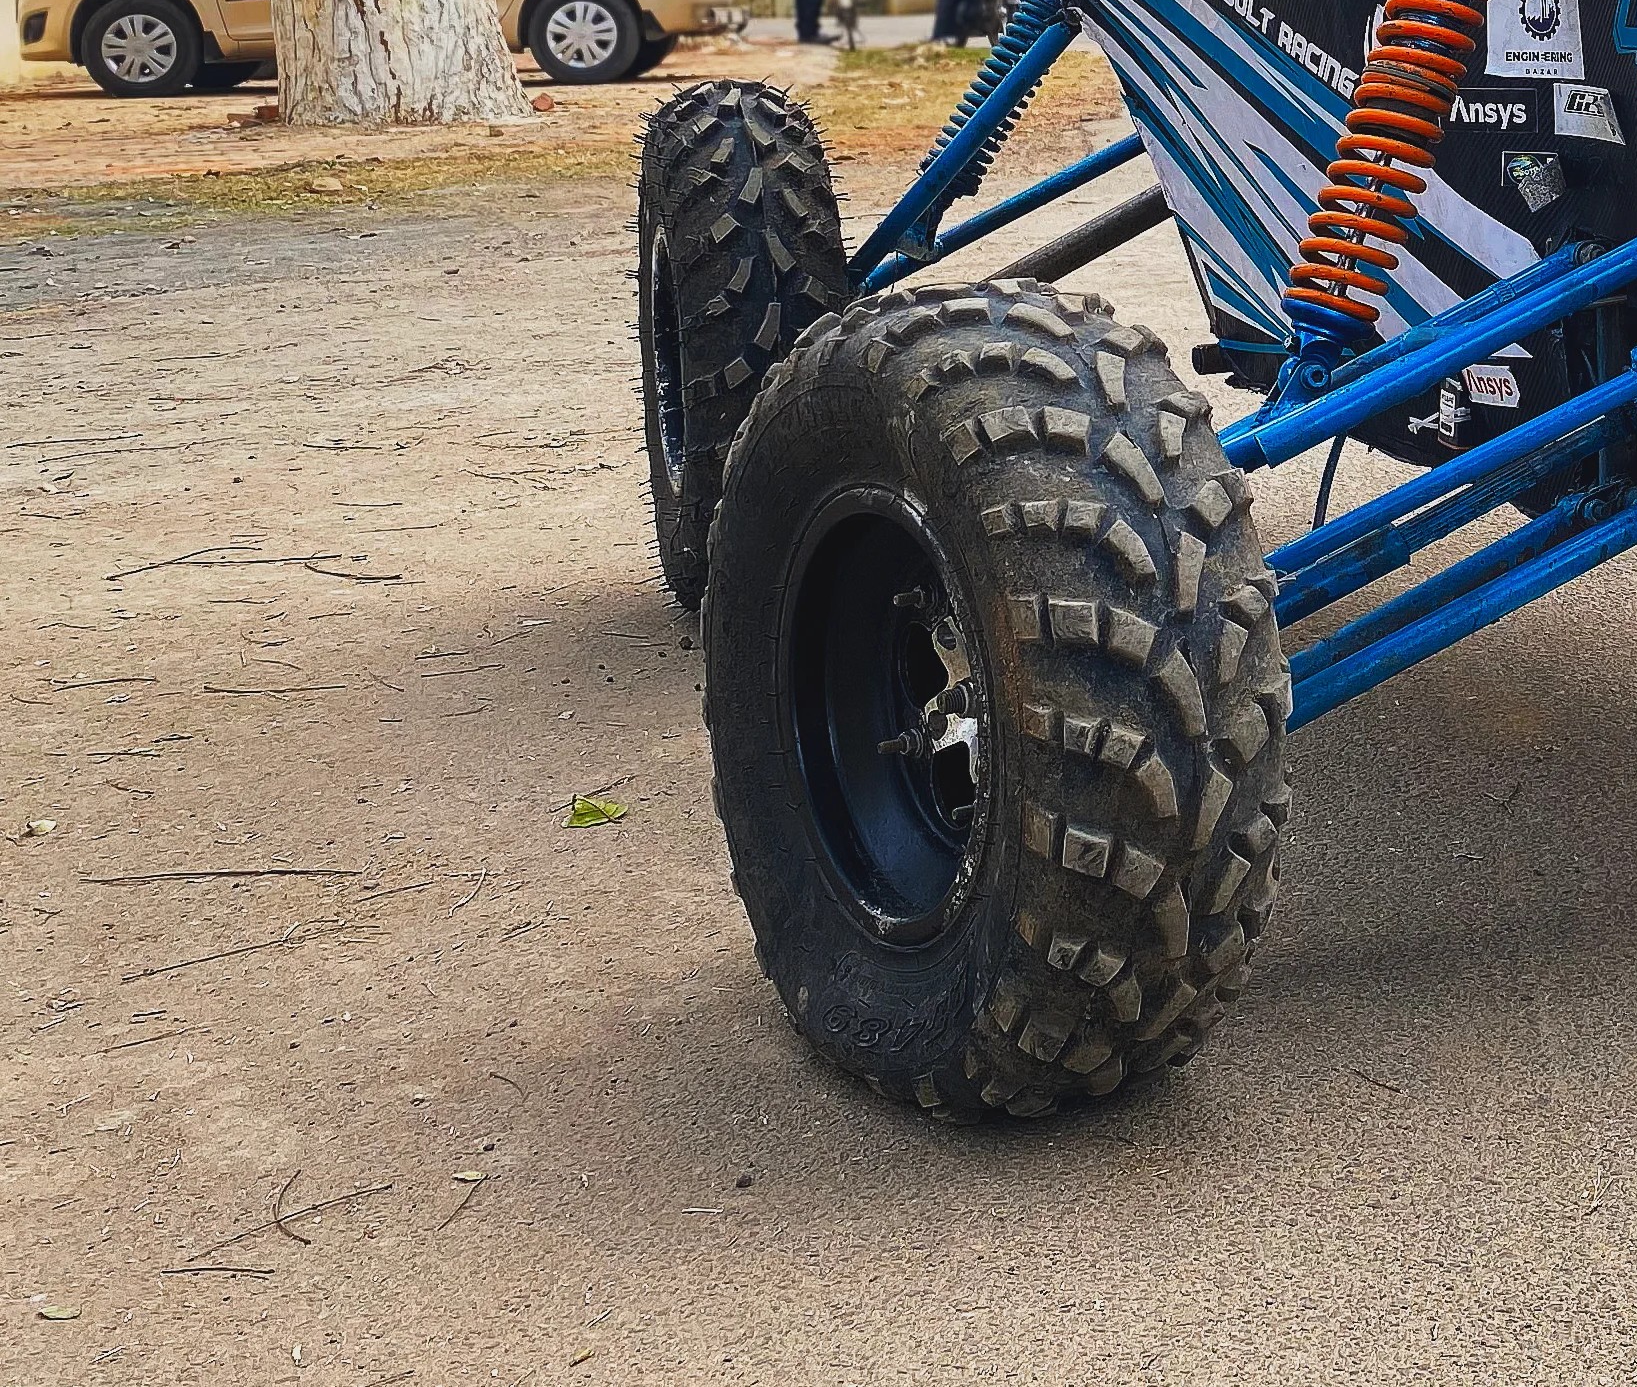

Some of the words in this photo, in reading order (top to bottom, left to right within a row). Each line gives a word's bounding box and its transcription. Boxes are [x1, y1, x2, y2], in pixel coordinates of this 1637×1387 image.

[1277, 21, 1359, 99] RACING
[1506, 51, 1573, 63] ENGINEERING
[1450, 95, 1527, 129] Ansys
[1467, 369, 1513, 402] Ansys
